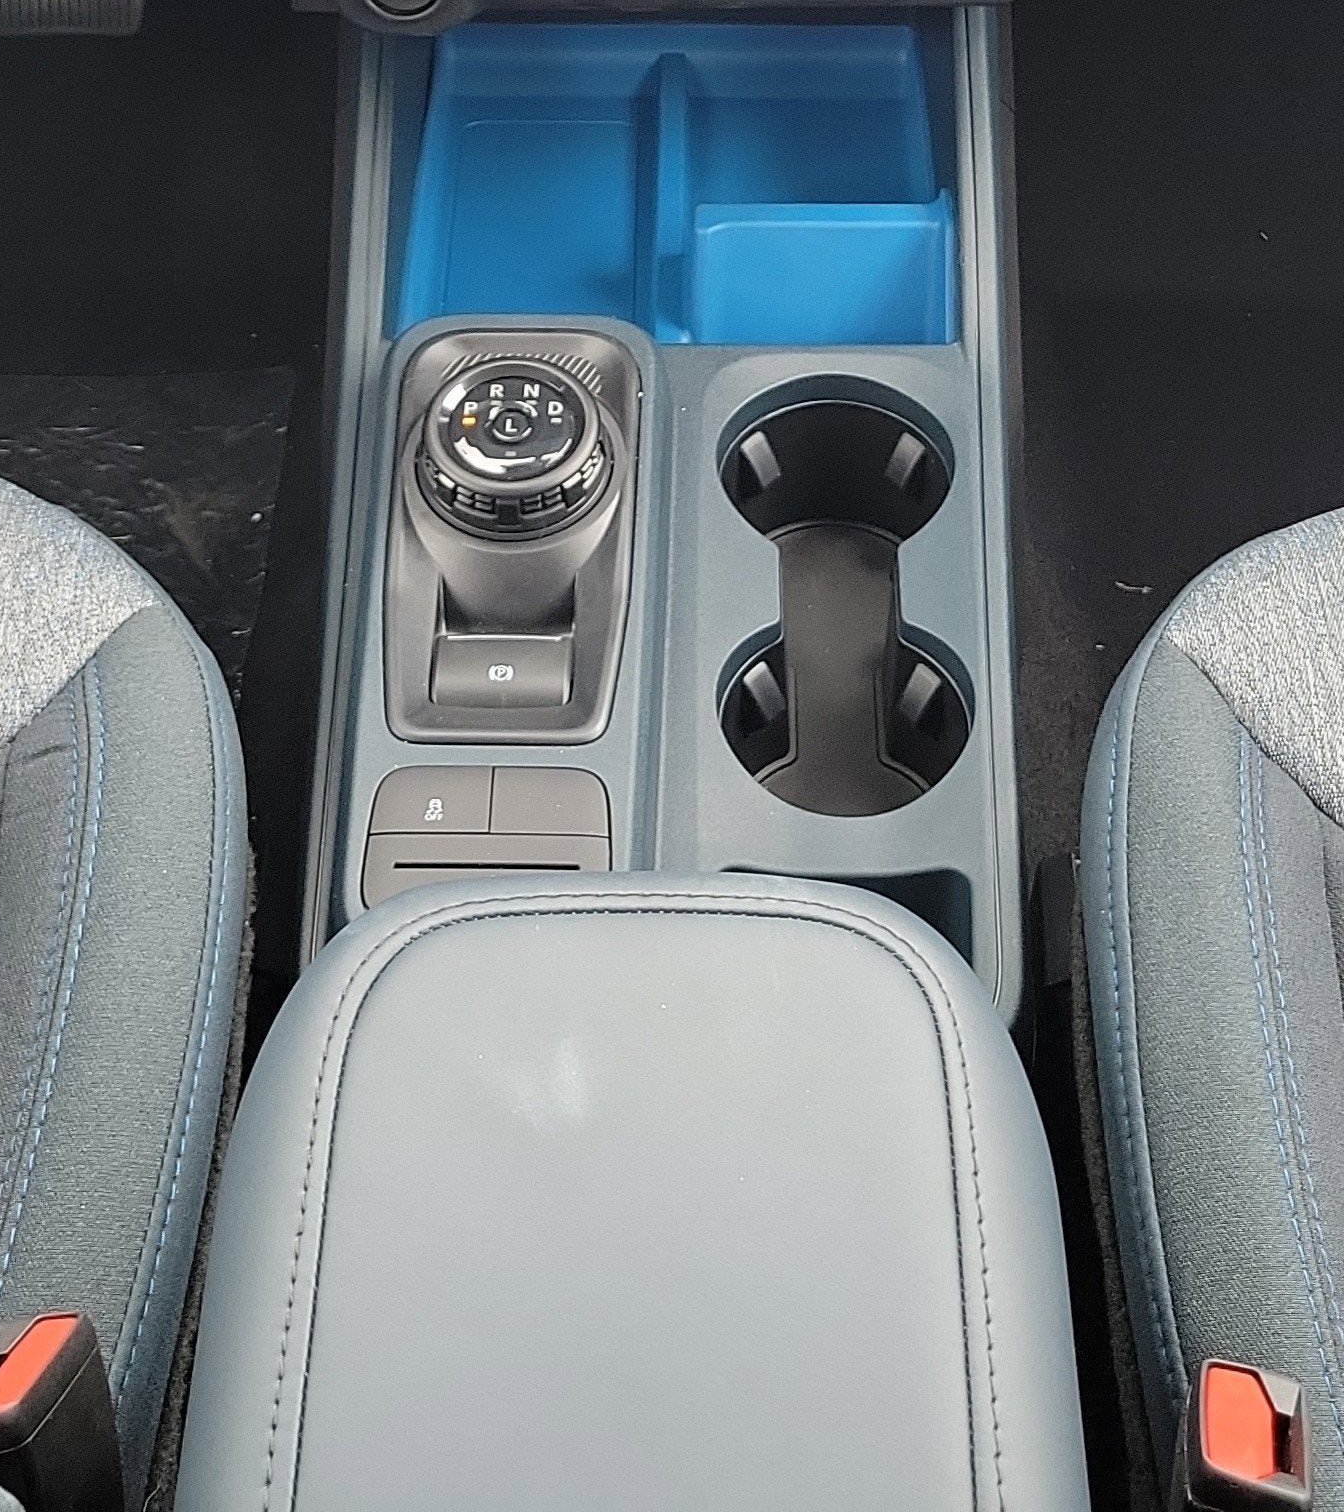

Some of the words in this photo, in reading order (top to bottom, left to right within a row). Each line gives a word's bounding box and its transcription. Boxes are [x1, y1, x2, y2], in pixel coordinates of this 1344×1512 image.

[489, 384, 504, 398] R
[523, 384, 540, 398] N
[463, 401, 478, 415] P
[548, 401, 564, 416] D
[505, 418, 518, 432] L
[424, 812, 443, 821] OFF
